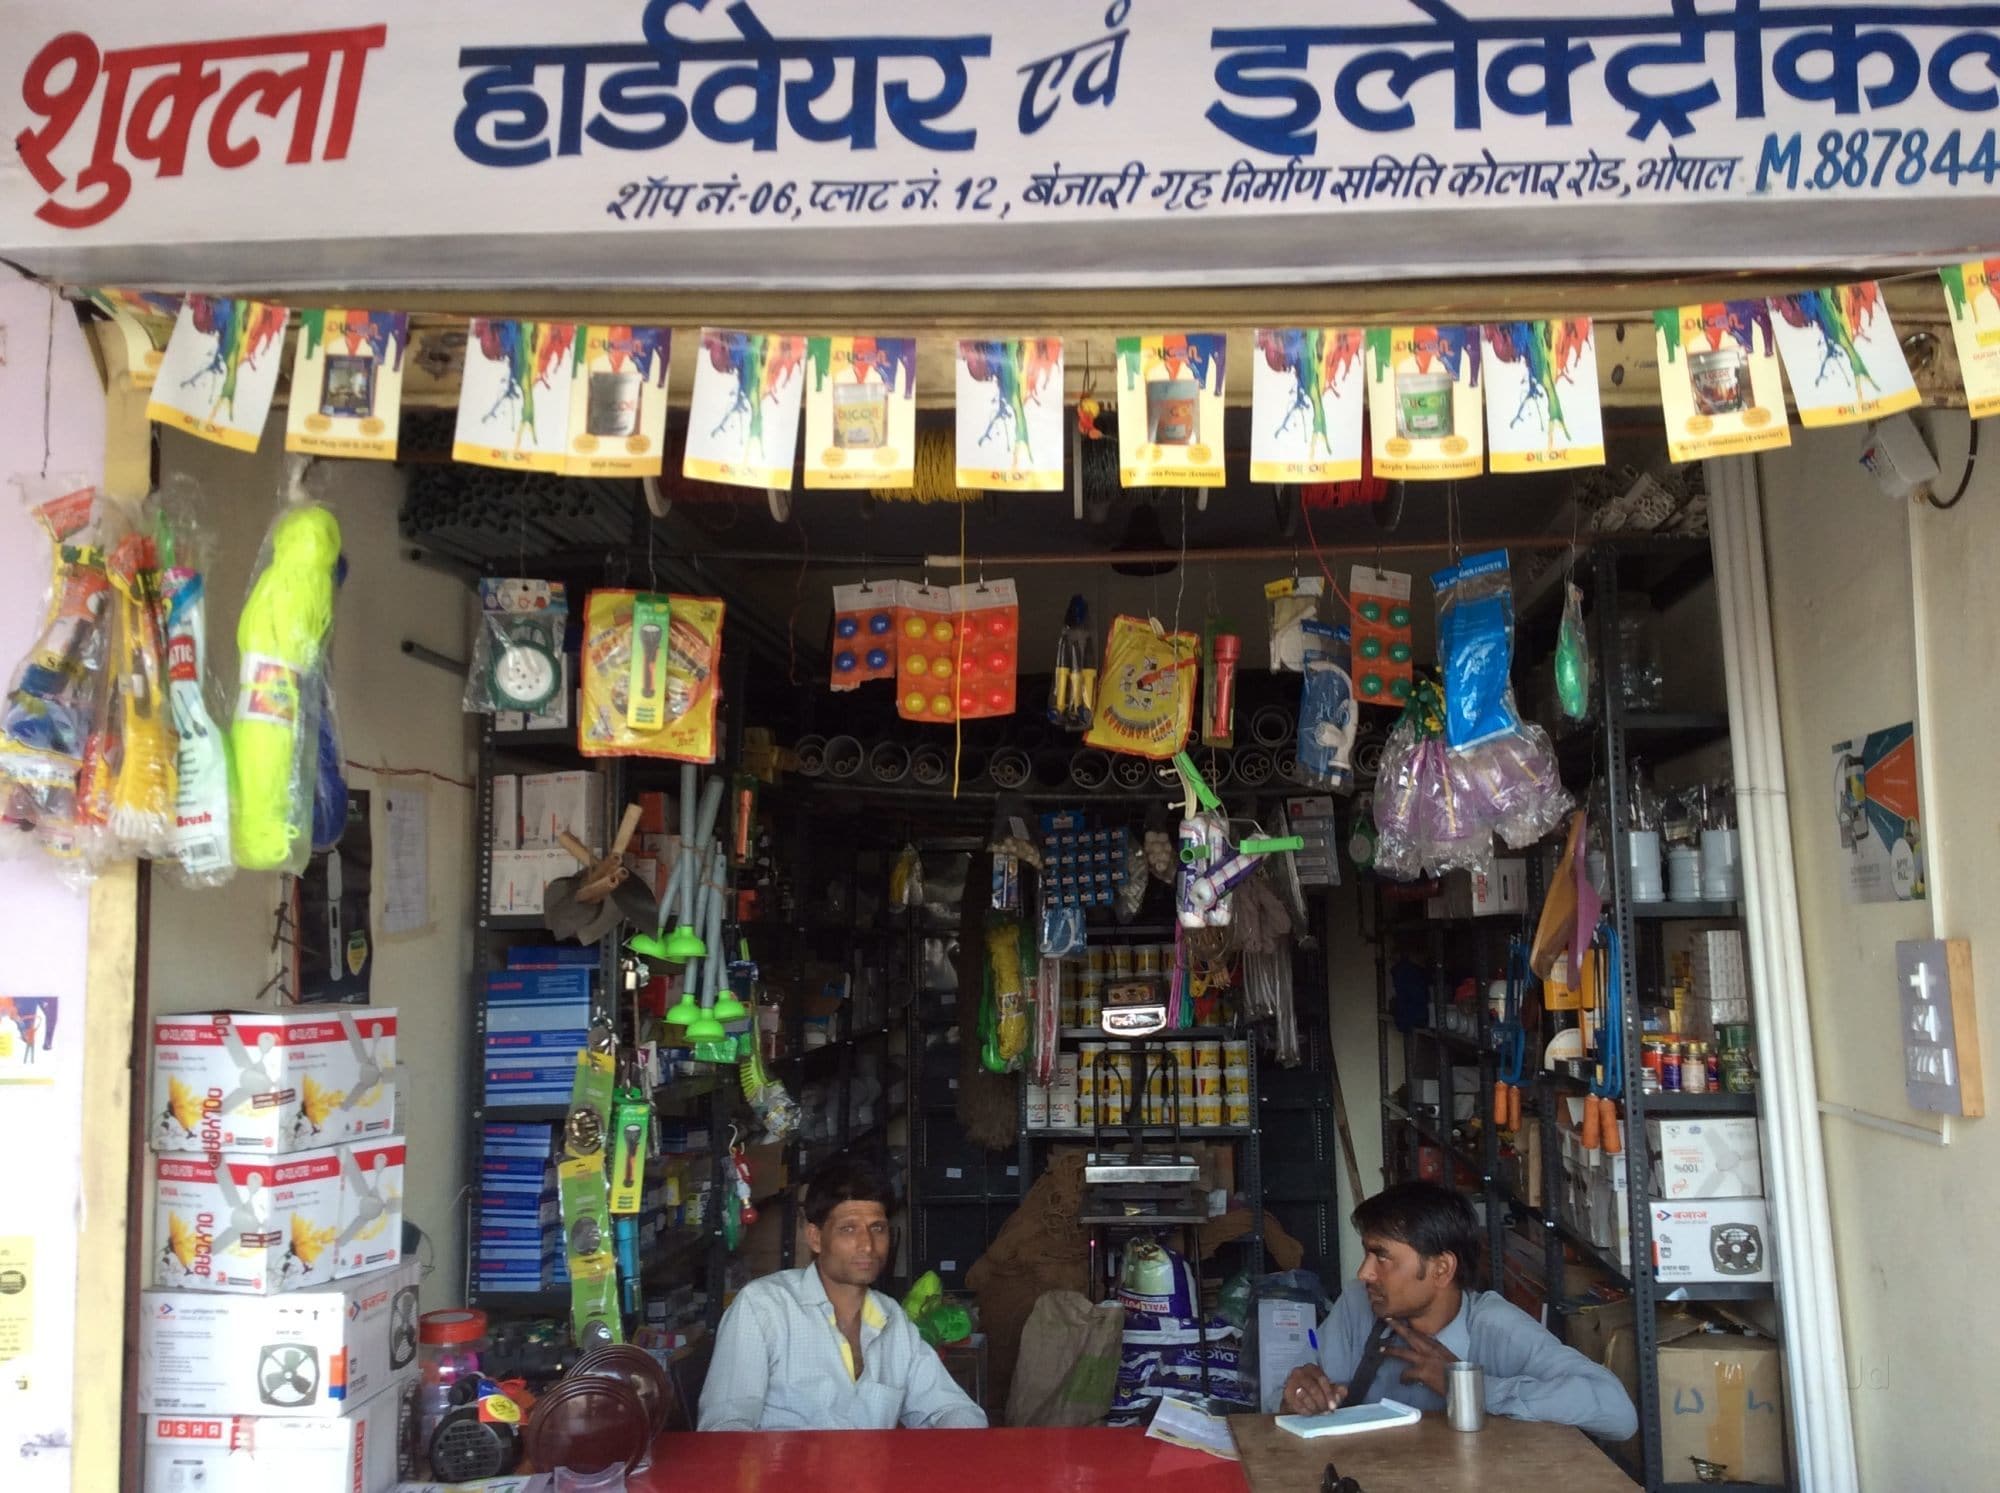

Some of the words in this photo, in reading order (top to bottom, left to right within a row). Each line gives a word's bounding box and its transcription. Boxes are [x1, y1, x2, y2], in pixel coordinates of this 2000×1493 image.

[16, 24, 387, 230] शुक्ला
[454, 0, 992, 167] हार्डवेयर
[1017, 0, 1130, 135] एवं
[606, 175, 698, 220] शॉप
[808, 178, 898, 214] प्लाट
[1022, 161, 1150, 210] बंजारी
[1151, 170, 1222, 211] गृह
[1221, 152, 1332, 203] निर्माण
[1330, 152, 1447, 202] समिति
[1448, 147, 1569, 200] कोलार
[1636, 144, 1743, 192] भोपाल
[157, 1421, 222, 1439] USHA
